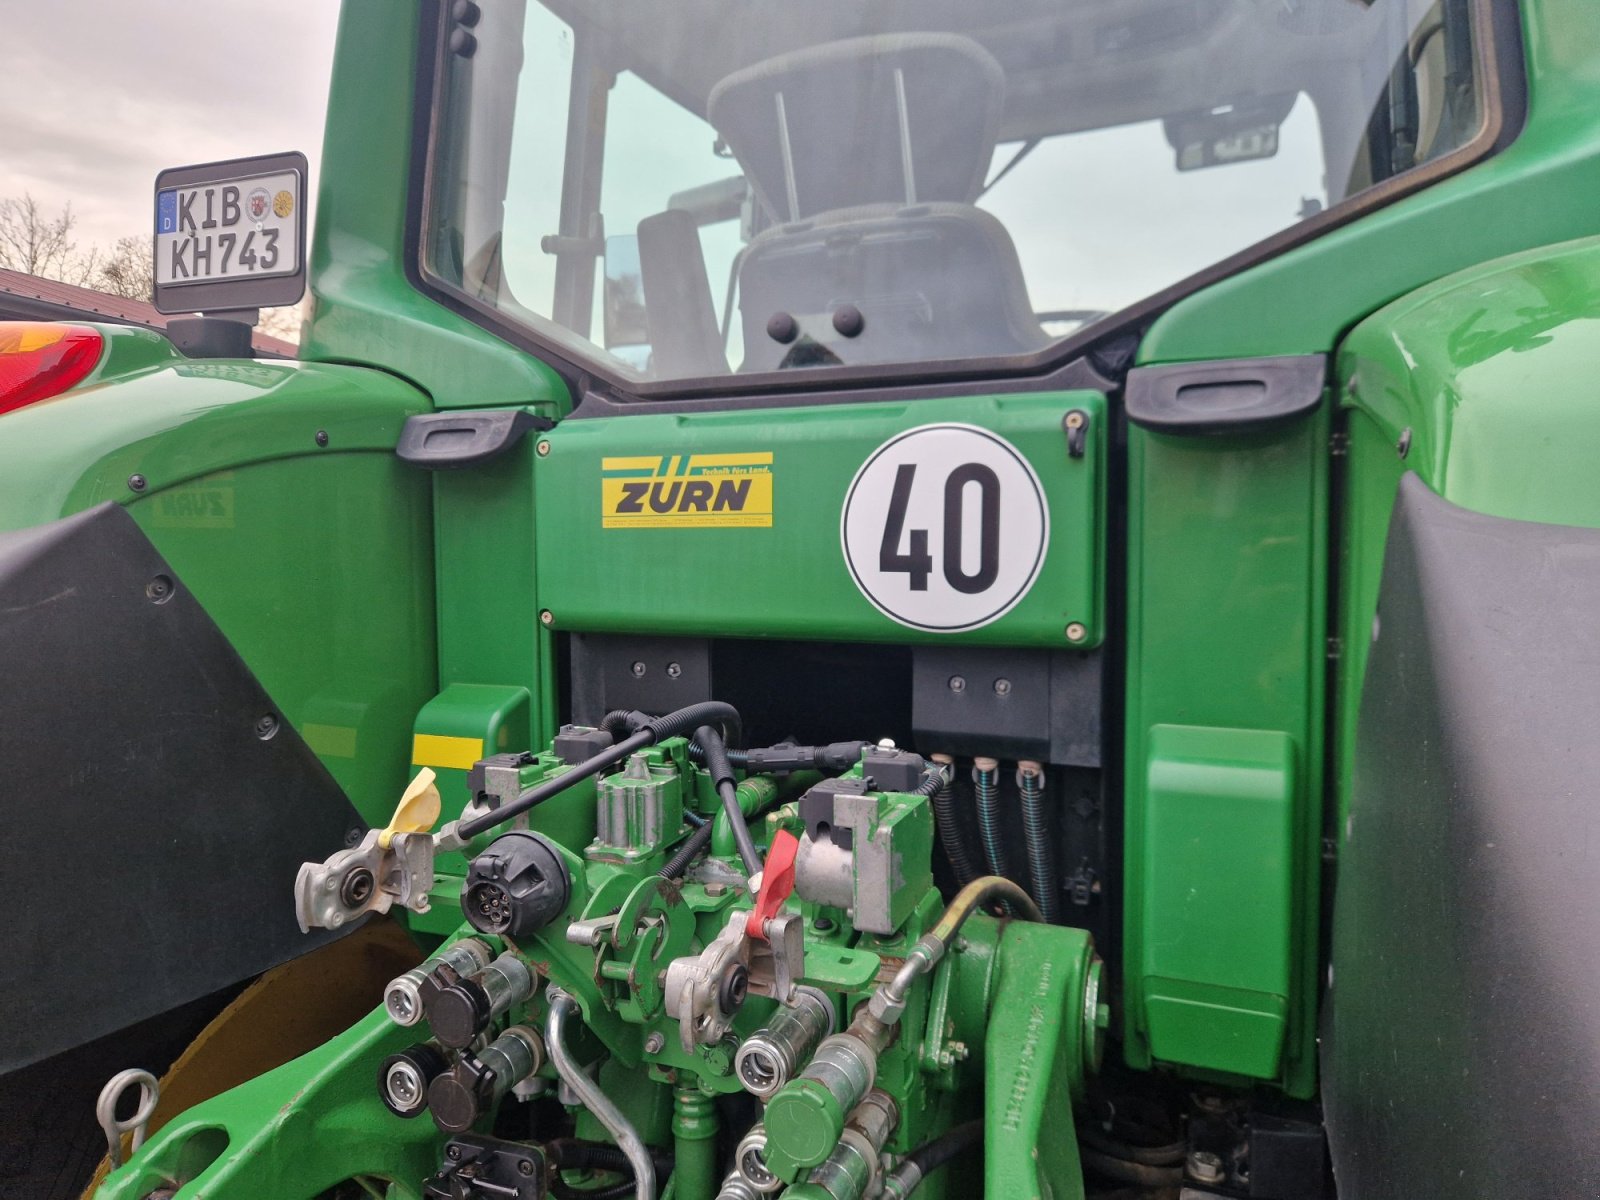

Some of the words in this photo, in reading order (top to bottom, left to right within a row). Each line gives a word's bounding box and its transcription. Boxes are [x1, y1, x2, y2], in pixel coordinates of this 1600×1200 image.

[164, 217, 171, 230] D
[179, 186, 241, 232] KIB
[879, 462, 1001, 595] 40
